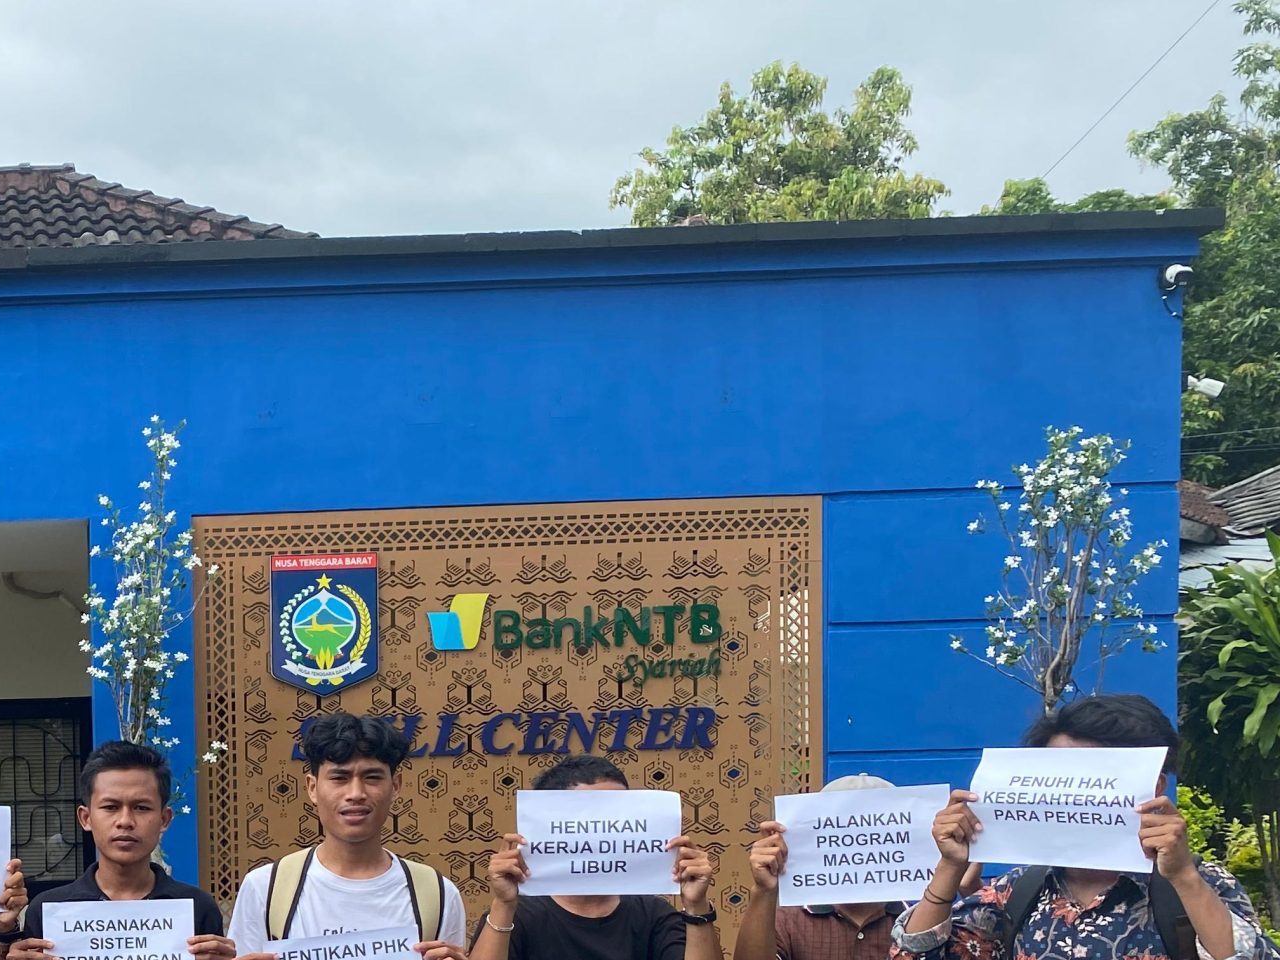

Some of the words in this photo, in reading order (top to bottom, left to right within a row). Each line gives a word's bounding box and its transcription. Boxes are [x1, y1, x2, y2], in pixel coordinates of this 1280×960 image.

[274, 559, 298, 568] NUSA
[299, 558, 344, 567] TENGGARA
[345, 556, 373, 566] BARAT
[618, 648, 722, 688] Syariah
[481, 706, 717, 755] CENTER
[1009, 776, 1074, 789] PENUHI
[1077, 777, 1118, 790] HAK
[983, 791, 1135, 808] KESEJAHTERAAN
[813, 811, 912, 830] JALANKAN
[994, 809, 1040, 822] PARA
[1045, 811, 1126, 826] PEKERJA
[551, 819, 646, 834] HENTIKAN
[816, 831, 910, 848] PROGRAM
[530, 841, 593, 854] KERJA
[599, 841, 616, 853] DI
[823, 850, 905, 866] MAGANG
[571, 861, 626, 874] LIBUR
[793, 872, 858, 887] SESUAI
[64, 918, 172, 932] LAKSANAKAN
[90, 937, 147, 950] SISTEM
[372, 938, 410, 955] PHK
